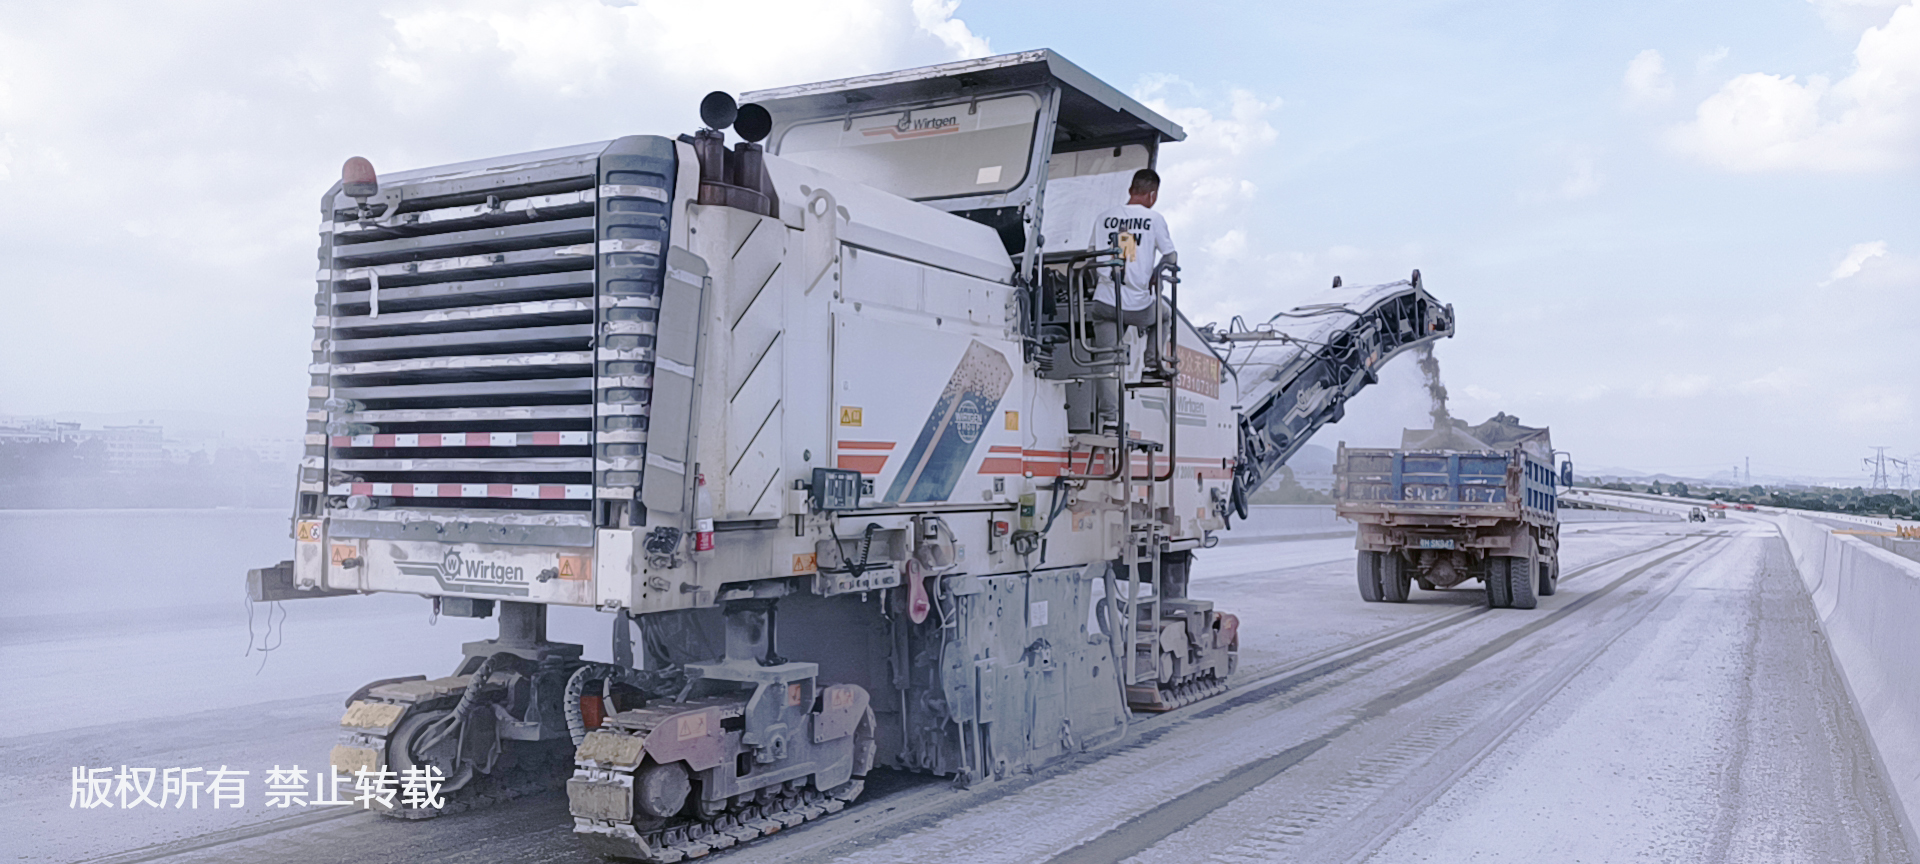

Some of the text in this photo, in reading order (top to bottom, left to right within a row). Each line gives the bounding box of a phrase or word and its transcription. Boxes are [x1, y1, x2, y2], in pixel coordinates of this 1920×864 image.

[913, 116, 957, 130] Wirtgen
[1104, 217, 1152, 231] COMING
[1107, 232, 1142, 246] SN
[465, 559, 524, 584] Wirtgen
